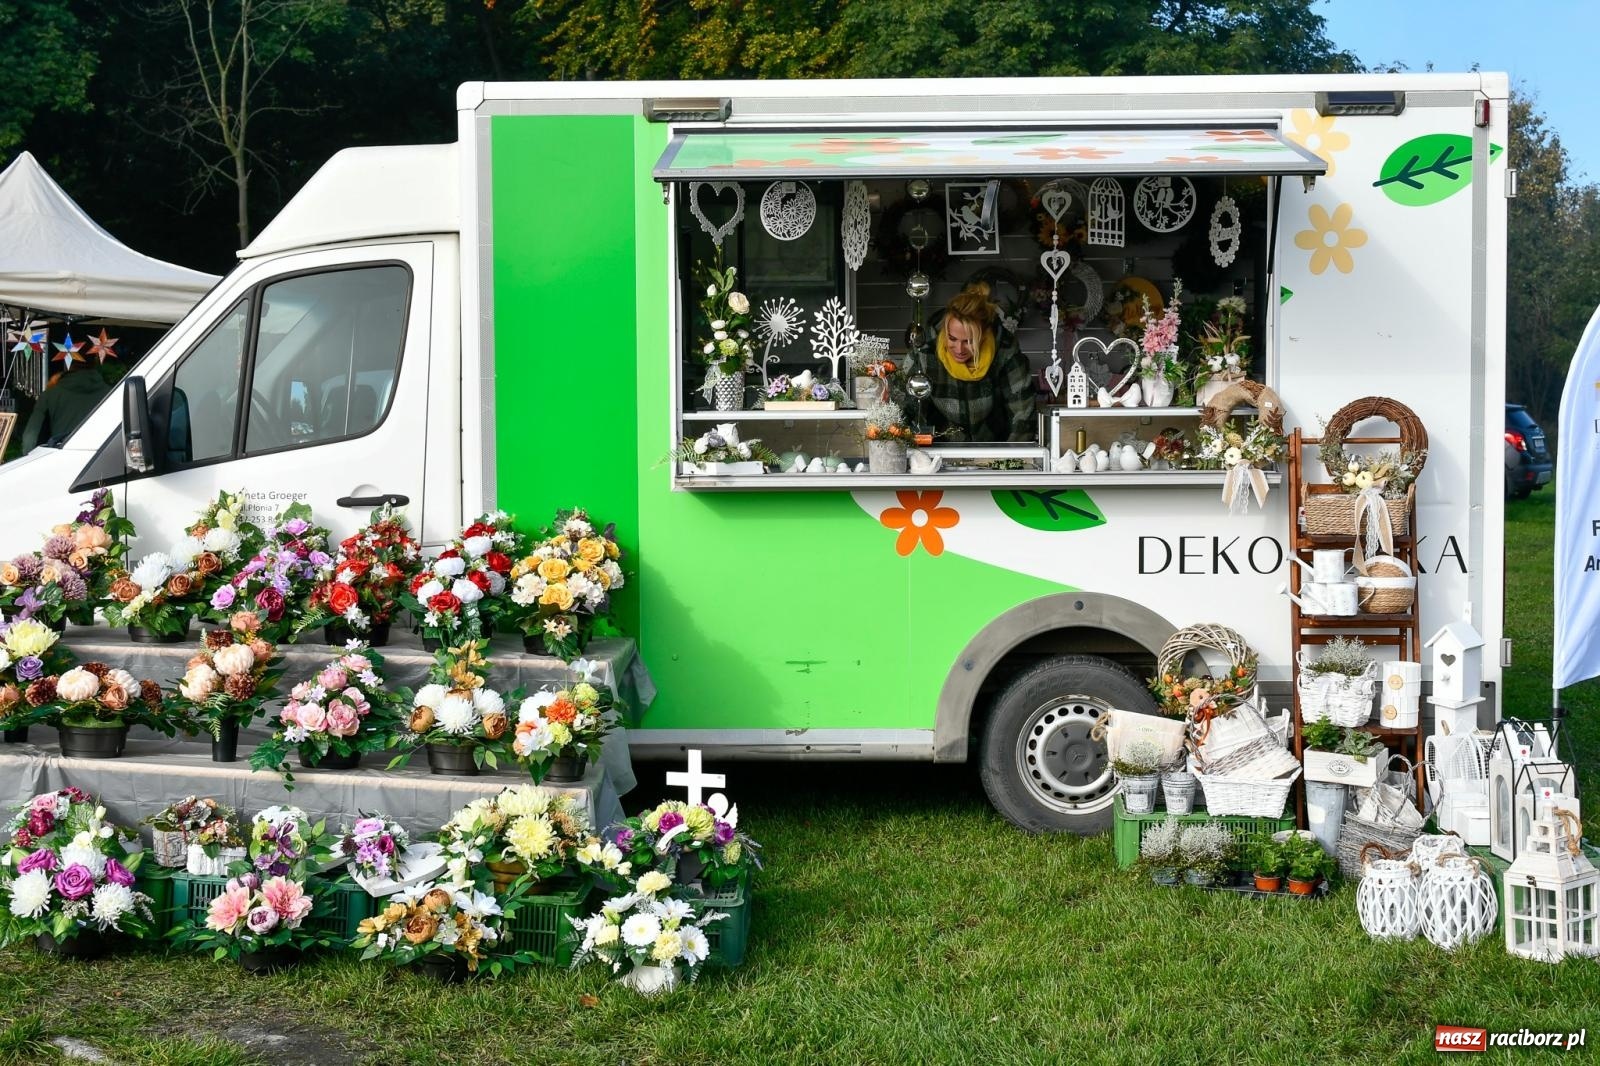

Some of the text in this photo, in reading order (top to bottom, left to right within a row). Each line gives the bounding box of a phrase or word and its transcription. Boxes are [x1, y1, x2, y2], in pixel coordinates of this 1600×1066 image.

[239, 491, 308, 502] neta Groeger
[1138, 535, 1468, 575] DEKOA
